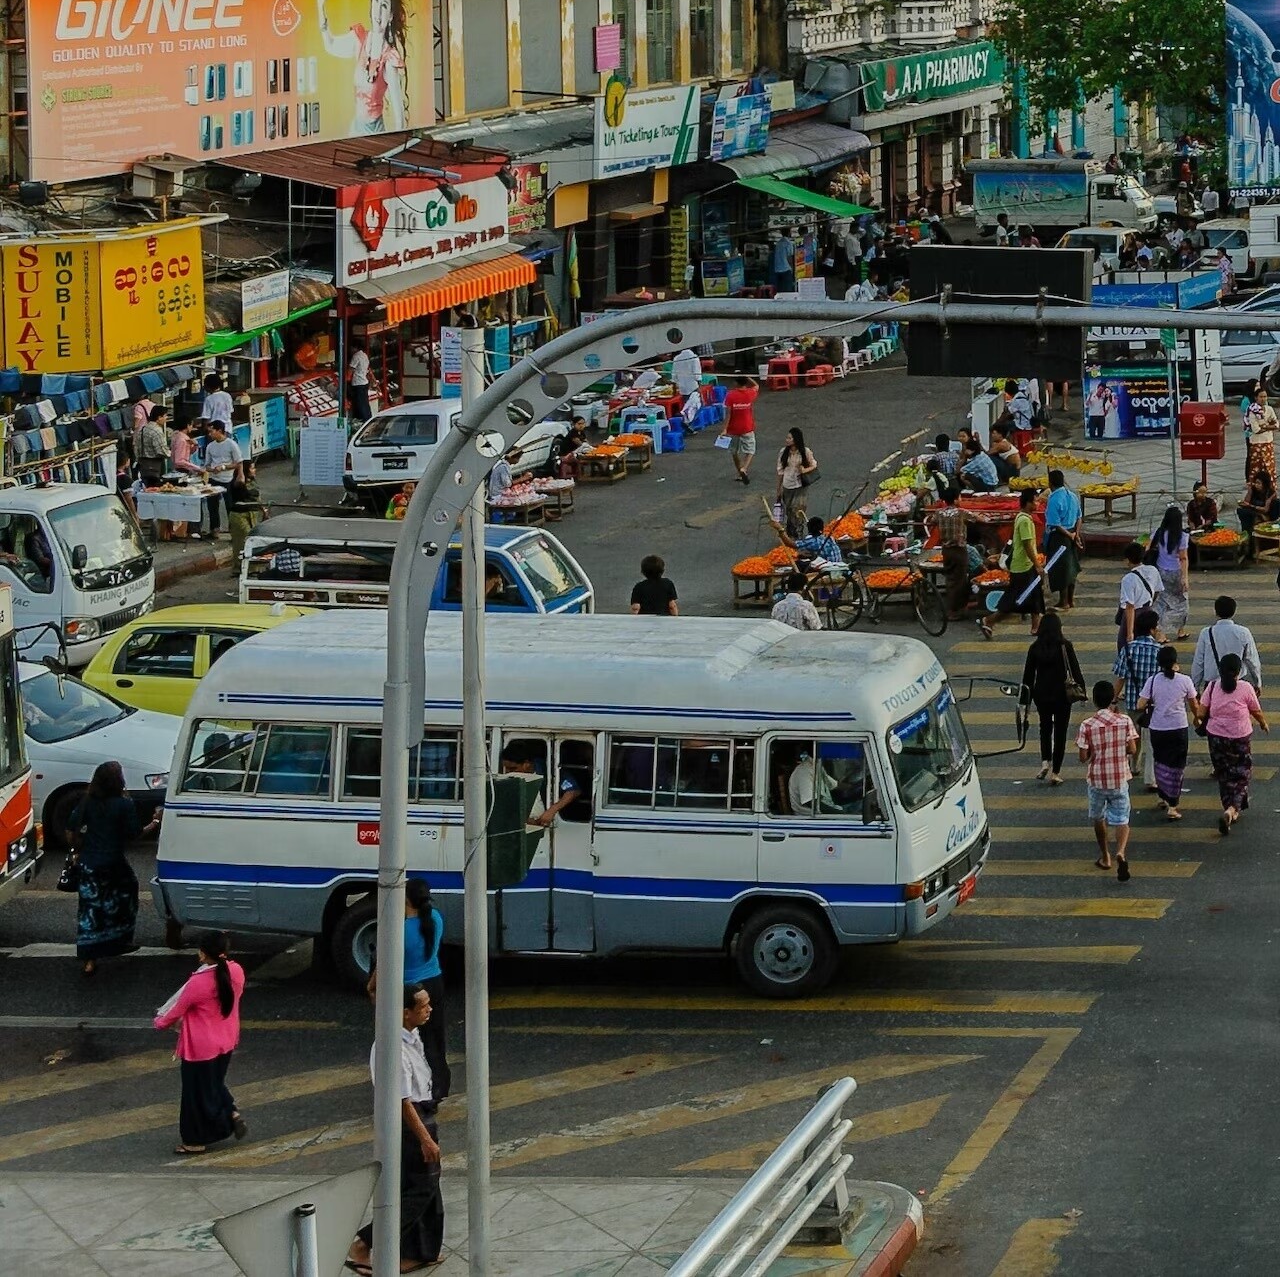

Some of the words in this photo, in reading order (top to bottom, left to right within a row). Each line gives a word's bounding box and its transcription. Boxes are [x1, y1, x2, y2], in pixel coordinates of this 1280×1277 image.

[52, 46, 101, 63] GOLDEN
[105, 43, 155, 59] QUALITY
[159, 41, 174, 53] TO
[178, 37, 216, 52] STAND
[219, 34, 248, 47] LONG
[925, 49, 990, 89] PHARMACY
[604, 131, 617, 147] UA
[619, 126, 653, 146] Ticketing
[660, 124, 680, 137] Tours
[426, 200, 448, 229] Co
[454, 194, 478, 223] Mo
[15, 244, 45, 372] SULAY
[55, 251, 73, 358] MOBILE
[89, 588, 122, 605] KHAING
[123, 577, 150, 595] KHAING
[108, 569, 134, 585] JAC
[881, 684, 920, 713] TOYOTA
